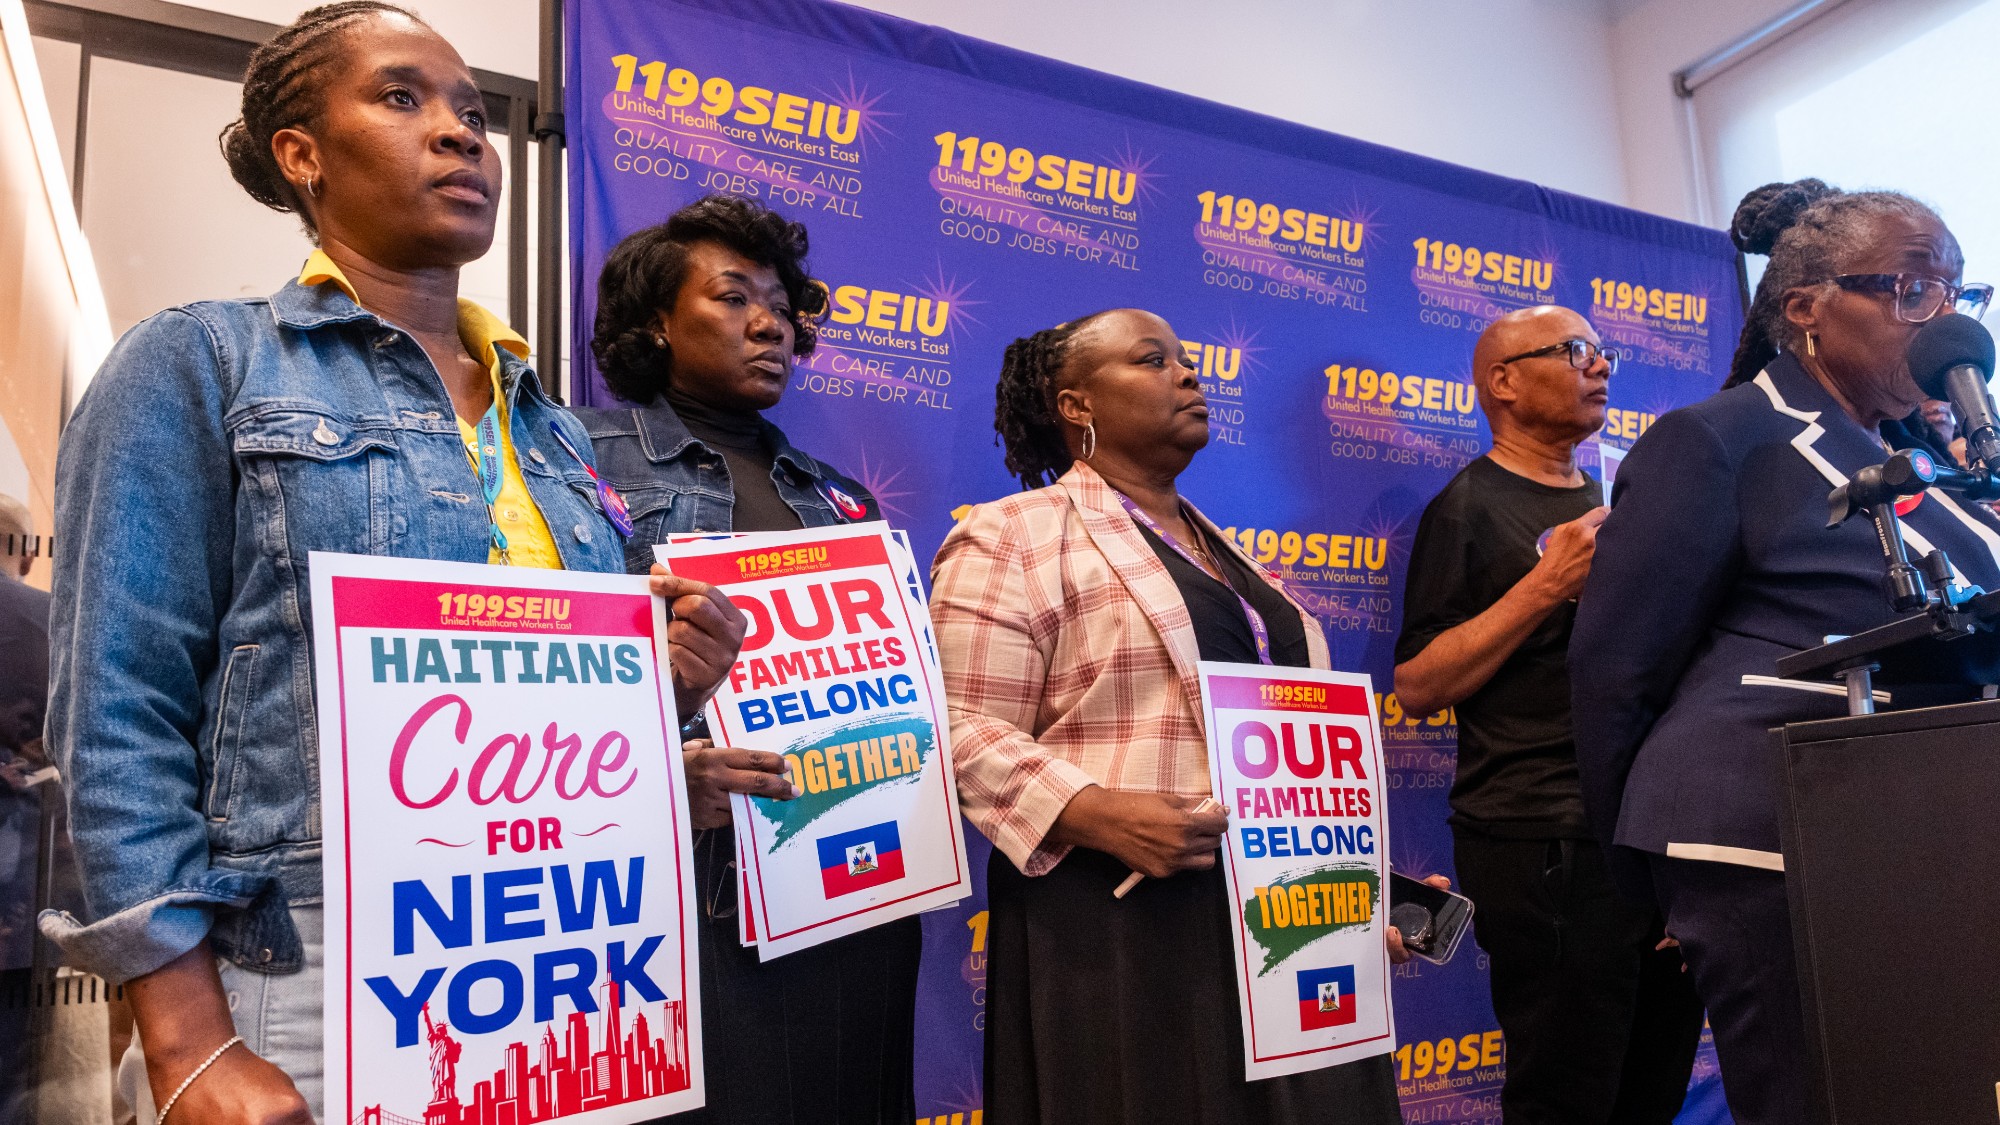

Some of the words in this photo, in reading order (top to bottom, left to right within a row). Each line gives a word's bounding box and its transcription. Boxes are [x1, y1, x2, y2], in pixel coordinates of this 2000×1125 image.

[611, 54, 860, 144] 1199SEIU
[614, 94, 665, 120] United
[672, 107, 756, 142] Healthcare
[761, 129, 825, 156] Workers
[831, 145, 859, 163] East
[615, 128, 727, 164] QUALITY
[736, 156, 802, 183] CARE
[810, 172, 861, 194] AND
[934, 132, 1136, 205] 1199SEIU
[615, 153, 689, 180] GOOD
[698, 171, 759, 196] JOBS
[770, 185, 815, 208] FOR
[823, 196, 863, 218] ALL
[938, 167, 980, 189] United
[985, 177, 1053, 205] Healthcare
[1057, 193, 1108, 216] Workers
[1113, 205, 1137, 222] East
[940, 197, 1029, 227] QUALITY
[1037, 218, 1091, 241] CARE
[1098, 230, 1139, 249] AND
[1197, 191, 1363, 252] 1199SEIU
[941, 219, 999, 244] GOOD
[1008, 233, 1056, 255] JOBS
[1064, 244, 1102, 263] FOR
[1108, 252, 1140, 271] ALL
[1201, 223, 1236, 242] United
[1240, 232, 1296, 254] Healthcare
[1299, 244, 1341, 263] Workers
[1345, 253, 1364, 267] East
[1203, 251, 1276, 276] QUALITY
[1283, 266, 1326, 286] CARE
[1333, 276, 1367, 293] AND
[1413, 238, 1552, 291] 1199SEIU
[1204, 270, 1253, 291] GOOD
[1260, 280, 1299, 300] JOBS
[1306, 290, 1336, 306] FOR
[1342, 297, 1367, 312] ALL
[1417, 268, 1446, 284] United
[1450, 275, 1496, 293] Healthcare
[1498, 284, 1533, 301] Workers
[1537, 291, 1555, 303] East
[1419, 291, 1479, 315] QUALITY
[1591, 278, 1706, 323] 1199SEIU
[810, 280, 949, 336] SEIU
[1420, 309, 1461, 328] GOOD
[856, 328, 916, 350] Workers
[921, 338, 949, 355] East
[1652, 338, 1683, 352] CARE
[1688, 344, 1710, 359] AND
[832, 355, 895, 379] CARE
[902, 366, 951, 386] AND
[1638, 352, 1666, 368] JOBS
[1668, 355, 1691, 370] FOR
[796, 375, 854, 396] JOBS
[863, 382, 907, 403] FOR
[915, 391, 952, 410] ALL
[1220, 382, 1241, 396] East
[1324, 364, 1475, 414] 1199SEIU
[1208, 407, 1244, 424] AND
[1328, 398, 1359, 413] United
[1363, 402, 1415, 420] Healthcare
[1417, 409, 1456, 425] Workers
[1459, 417, 1477, 428] East
[1216, 428, 1245, 445] ALL
[1330, 423, 1397, 443] QUALITY
[1404, 431, 1443, 449] CARE
[1445, 437, 1479, 454] AND
[1332, 442, 1376, 459] GOOD
[1382, 449, 1418, 465] JOBS
[1424, 454, 1450, 468] FOR
[736, 546, 827, 572] 1199SEIU
[1322, 569, 1365, 584] Workers
[1369, 574, 1388, 585] East
[438, 593, 570, 620] 1199SEIU
[1305, 594, 1349, 611] CARE
[1357, 598, 1391, 613] AND
[441, 616, 469, 626] United
[472, 618, 517, 628] Healthcare
[520, 620, 553, 629] Workers
[556, 621, 571, 630] East
[1329, 616, 1360, 630] FOR
[1366, 617, 1392, 632] ALL
[371, 637, 643, 684] HAITIANS
[728, 636, 907, 694] FAMILIES
[738, 673, 918, 732] BELONG
[1259, 685, 1325, 703] 1199SEIU
[1232, 721, 1368, 780] OUR
[1389, 727, 1441, 740] Healthcare
[389, 694, 637, 809] Care
[772, 732, 921, 802] OGETHER
[1383, 754, 1423, 769] ALITY
[1429, 753, 1458, 768] CAR
[1408, 773, 1445, 788] JOBS
[1236, 787, 1371, 819] FAMILIES
[486, 817, 563, 855] FOR
[1241, 825, 1374, 858] BELONG
[393, 856, 645, 956] NEW
[1254, 882, 1371, 929] TOGETHER
[1395, 962, 1422, 978] ALL
[363, 934, 668, 1048] YORK
[1396, 1079, 1416, 1096] ited
[1419, 1073, 1472, 1093] Healthcare
[1475, 1066, 1506, 1082] Worke
[1461, 1094, 1502, 1115] CARE
